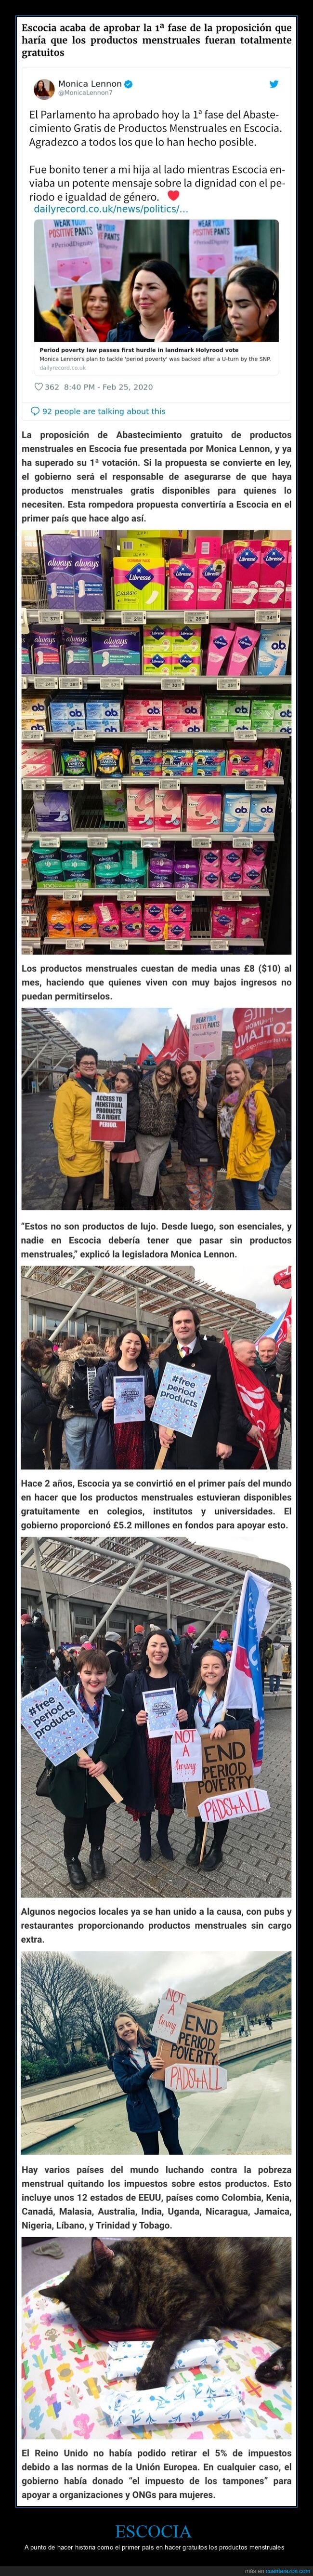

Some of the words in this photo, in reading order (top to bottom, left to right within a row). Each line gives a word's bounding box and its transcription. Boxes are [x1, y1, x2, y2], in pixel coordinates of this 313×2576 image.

[48, 228, 74, 238] POSITIVE
[75, 227, 93, 236] PANTS
[48, 558, 72, 569] always
[75, 559, 99, 570] always
[34, 636, 56, 645] always
[66, 636, 88, 644] always
[104, 637, 128, 647] always
[271, 640, 287, 650] o.b.
[172, 1375, 196, 1388] #free
[167, 1384, 196, 1398] period
[160, 1390, 198, 1408] products
[28, 1696, 55, 1716] #free
[33, 1702, 65, 1728] period
[34, 1708, 76, 1740] products
[175, 1730, 196, 1743] NOT
[183, 1745, 190, 1757] A
[204, 1741, 246, 1763] END
[203, 1762, 247, 1779] PERIOD
[198, 1775, 252, 1794] POVERTY
[204, 1790, 265, 1821] PADS4ALL
[166, 1989, 186, 2004] NOT
[168, 2003, 174, 2016] A
[185, 2014, 218, 2036] END
[179, 2032, 215, 2051] PERIOD
[170, 2043, 218, 2066] POVERTY
[170, 2066, 222, 2090] PADS4ALL
